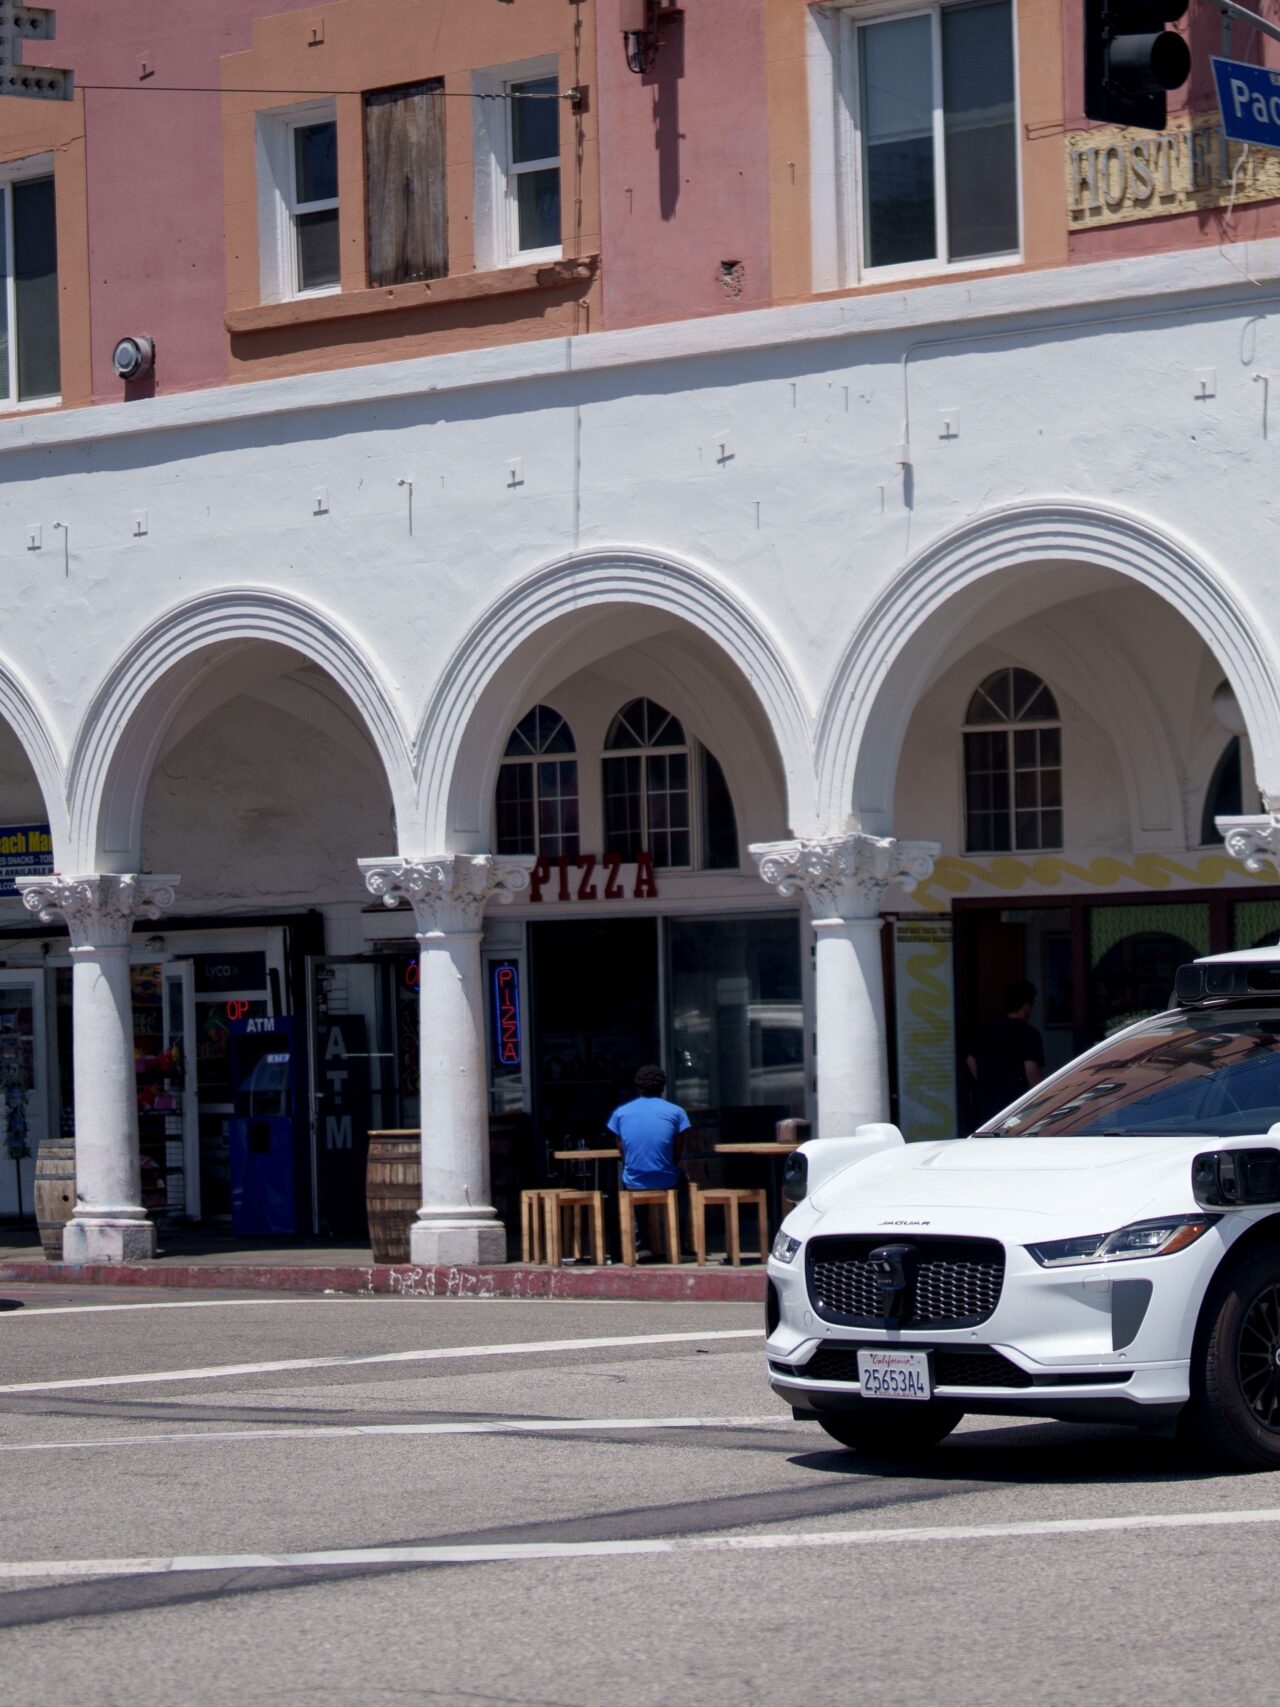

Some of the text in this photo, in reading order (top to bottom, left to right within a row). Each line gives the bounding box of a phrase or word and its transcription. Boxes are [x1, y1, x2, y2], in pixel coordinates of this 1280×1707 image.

[1071, 127, 1246, 208] HOSTEL
[0, 832, 26, 854] ach
[530, 851, 658, 902] PIZZA
[247, 1018, 275, 1032] ATM
[499, 969, 518, 1060] PIZZA
[325, 1026, 353, 1150] ATM
[873, 1354, 912, 1367] California
[864, 1368, 925, 1395] 25653A4
